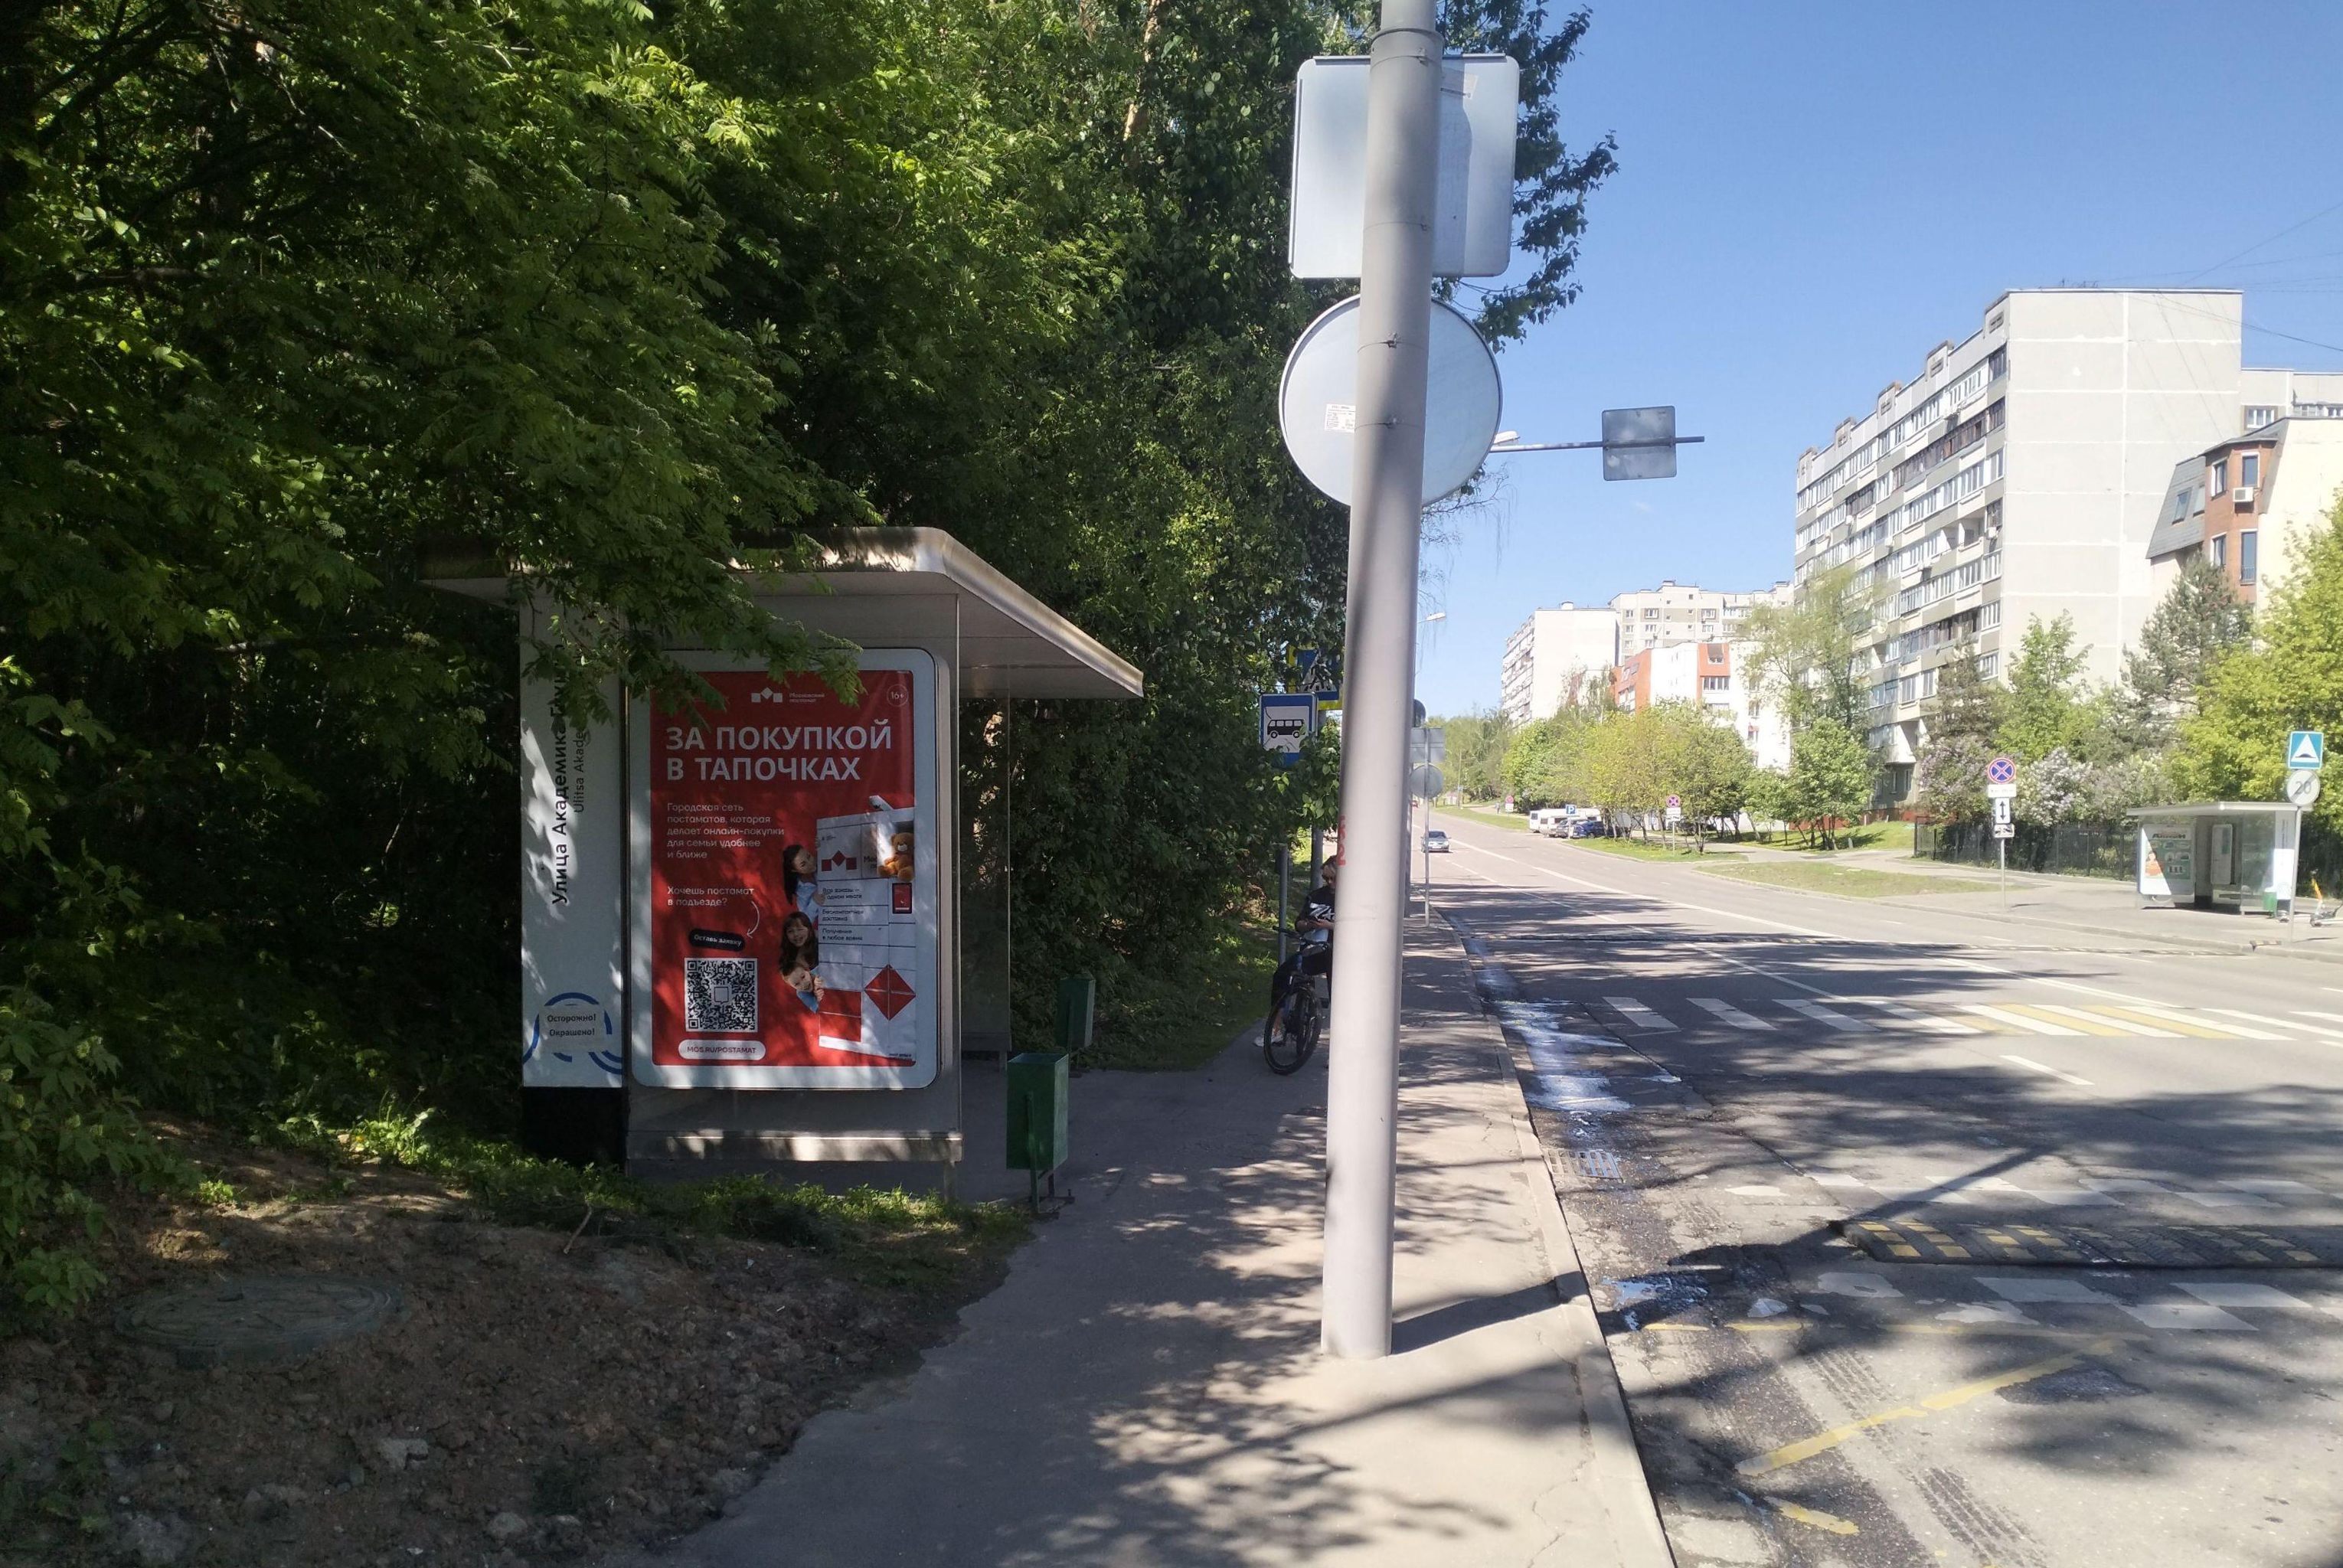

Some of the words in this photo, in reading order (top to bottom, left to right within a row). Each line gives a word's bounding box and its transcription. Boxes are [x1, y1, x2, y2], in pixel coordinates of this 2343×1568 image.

[890, 691, 904, 700] 16+
[666, 727, 706, 750] ЗА
[717, 718, 892, 750] ПОКУПКОЙ
[667, 757, 684, 780] В
[694, 756, 861, 781] ТАПОЧКАХ
[2296, 781, 2311, 795] 20
[574, 777, 584, 813] Ulitsa
[667, 803, 718, 812] Городская
[667, 816, 727, 825] постаматов,
[730, 816, 771, 825] которая
[667, 828, 701, 836] делает
[703, 827, 784, 837] онлайн-покупки
[720, 838, 760, 848] удобнее
[676, 850, 707, 858] ближе
[552, 844, 569, 905] Улица
[667, 886, 704, 895] Хочешь
[675, 897, 728, 907] подъезде?
[694, 934, 717, 943] Оставь
[718, 938, 742, 947] заявку
[547, 1014, 596, 1023] Осторожно!
[549, 1028, 595, 1037] Окрашено!
